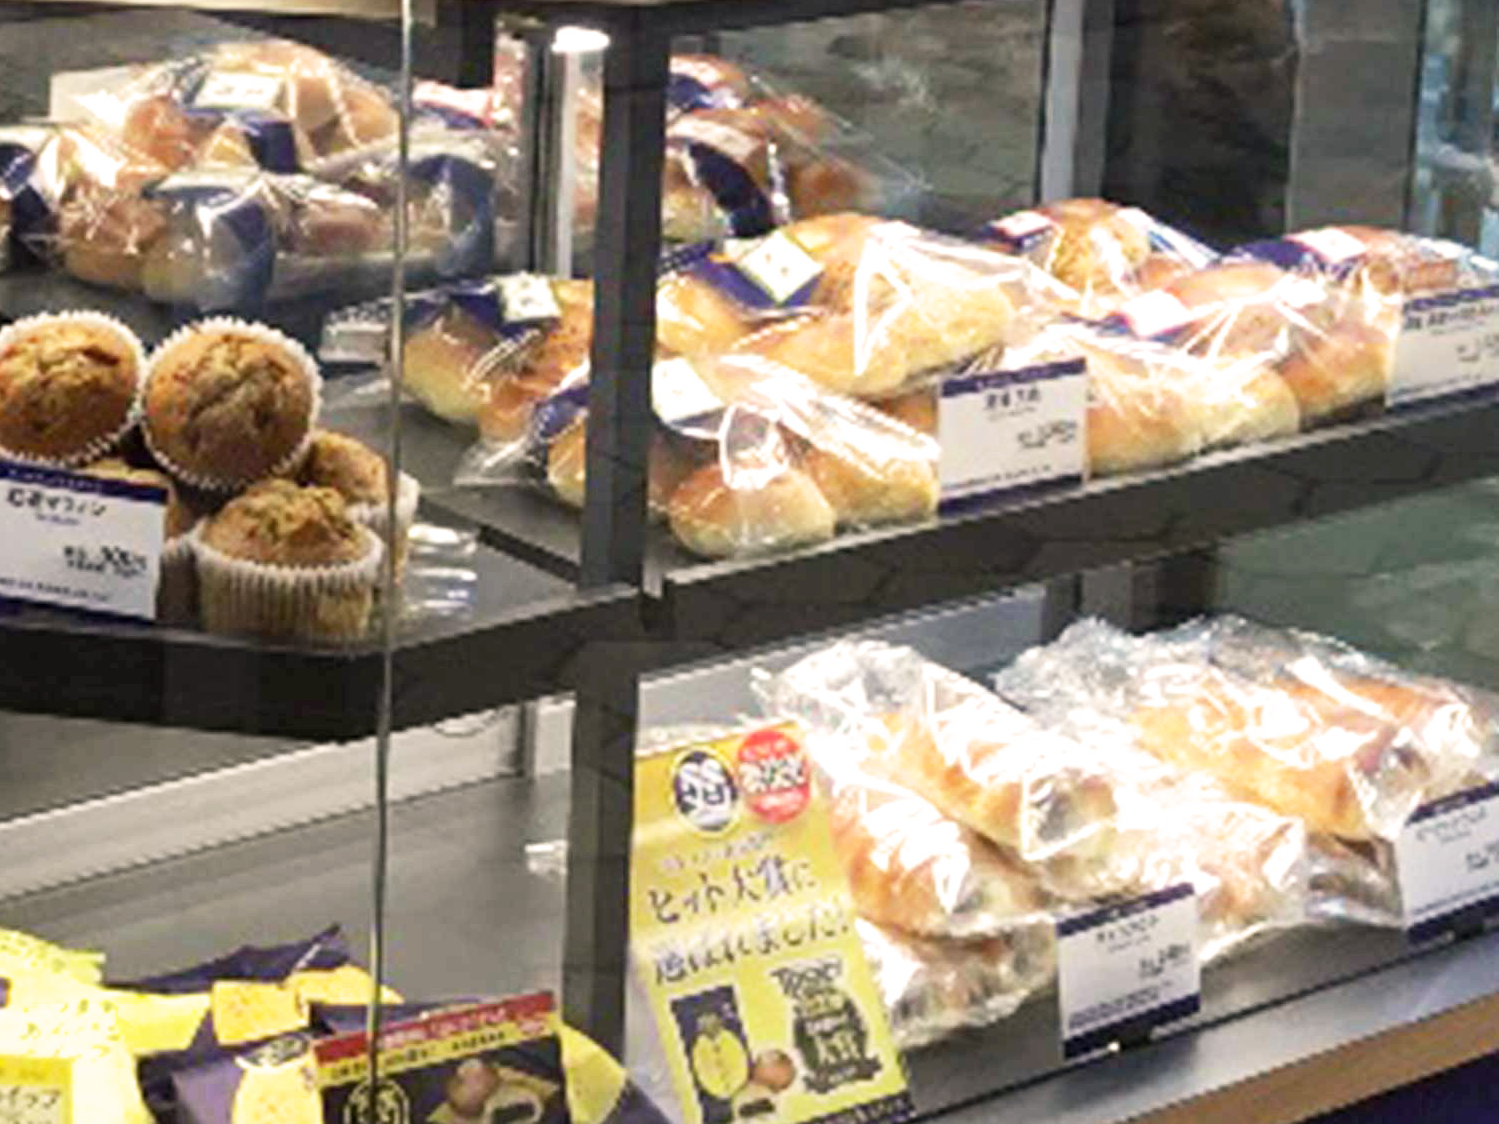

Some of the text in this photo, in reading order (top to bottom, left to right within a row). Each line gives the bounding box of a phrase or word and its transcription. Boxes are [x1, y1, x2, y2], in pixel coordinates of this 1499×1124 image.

[647, 853, 818, 925] ヒット大賞に
